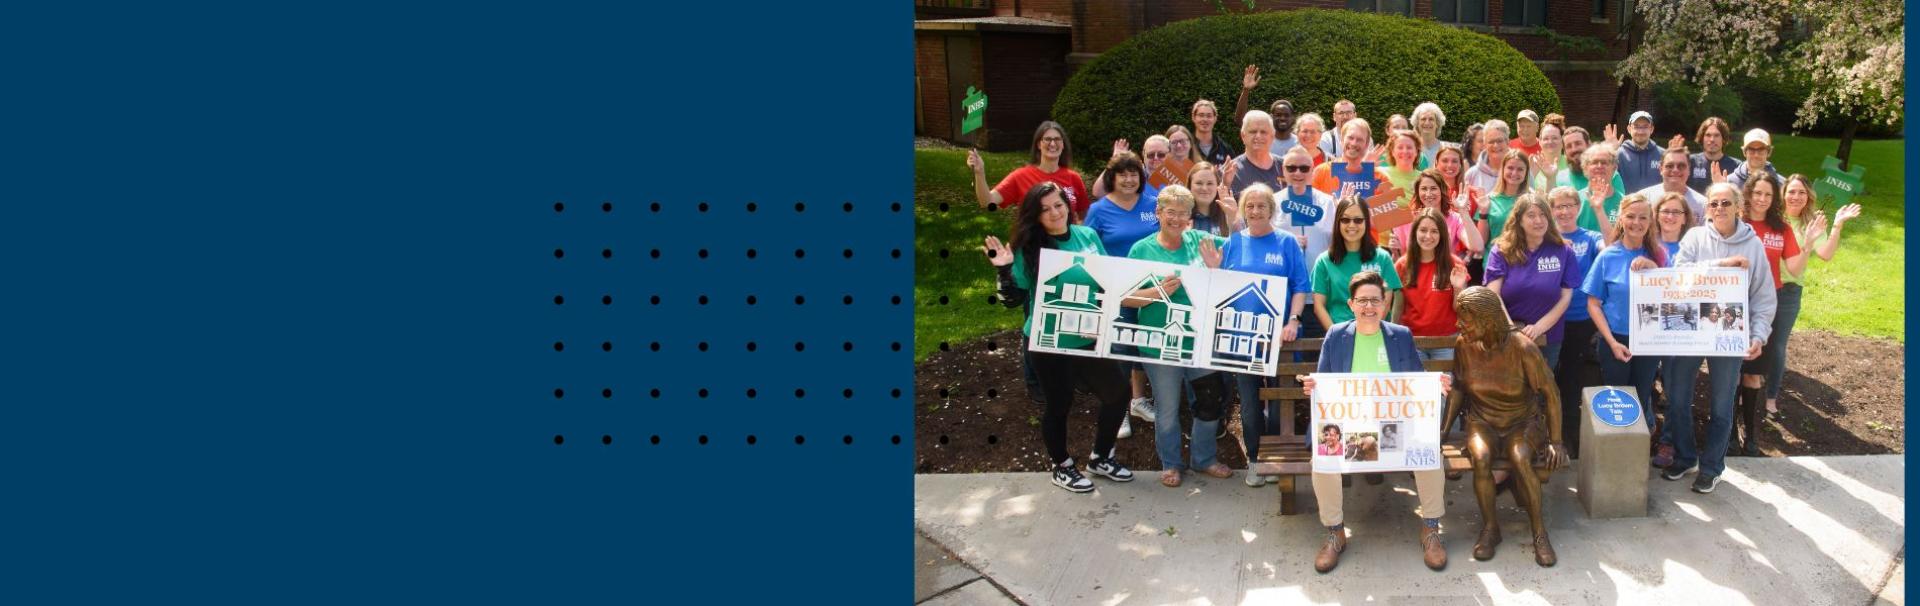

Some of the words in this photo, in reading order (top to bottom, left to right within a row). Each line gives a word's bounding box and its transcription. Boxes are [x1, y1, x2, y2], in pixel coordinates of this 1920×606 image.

[968, 99, 984, 113] INHS
[1826, 176, 1853, 192] INHS
[1287, 200, 1318, 217] INHS
[1369, 200, 1398, 217] INHS
[1538, 263, 1561, 271] INHS
[1640, 273, 1673, 289] Lucy
[1693, 273, 1739, 286] Brown
[1715, 343, 1744, 352] INHS
[1339, 378, 1417, 397] THANK
[1317, 401, 1369, 422] YOU,
[1374, 400, 1436, 419] LUCY!
[1405, 456, 1436, 466] INHS
